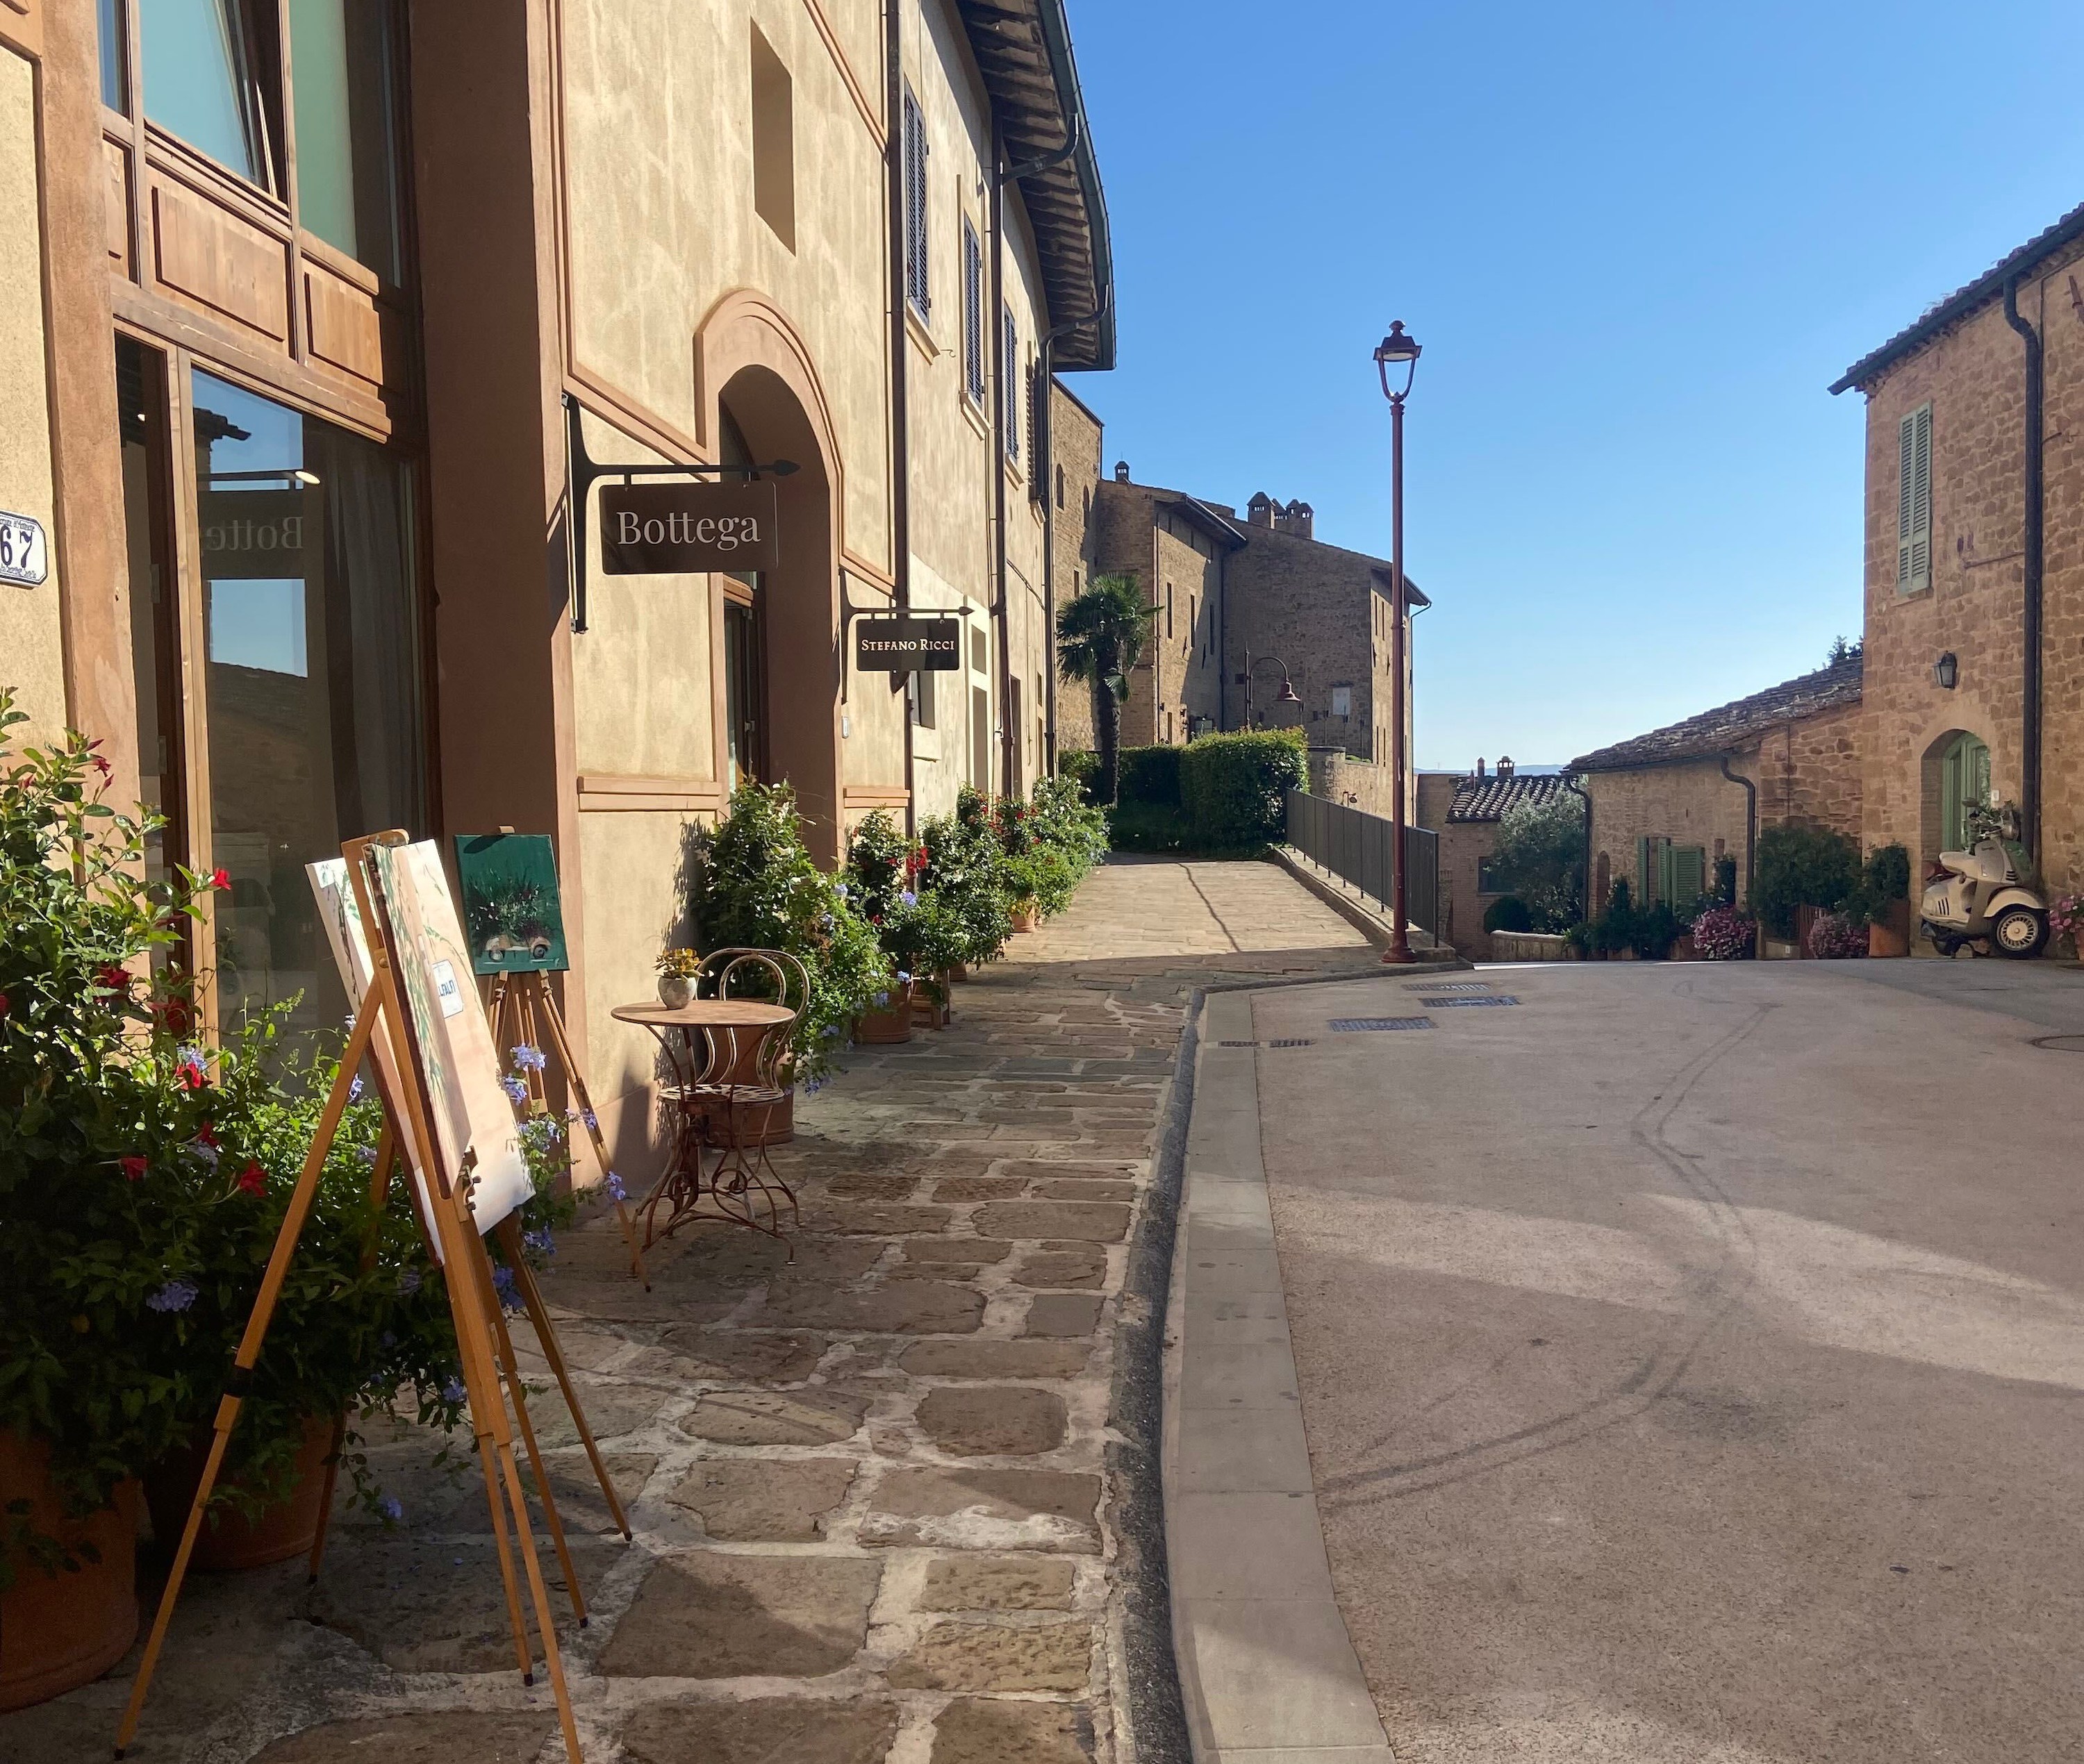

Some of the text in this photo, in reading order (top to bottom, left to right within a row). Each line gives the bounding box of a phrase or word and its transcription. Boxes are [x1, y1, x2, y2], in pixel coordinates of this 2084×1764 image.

[617, 511, 761, 551] Bottega
[861, 639, 954, 651] STEFANO RICCI
